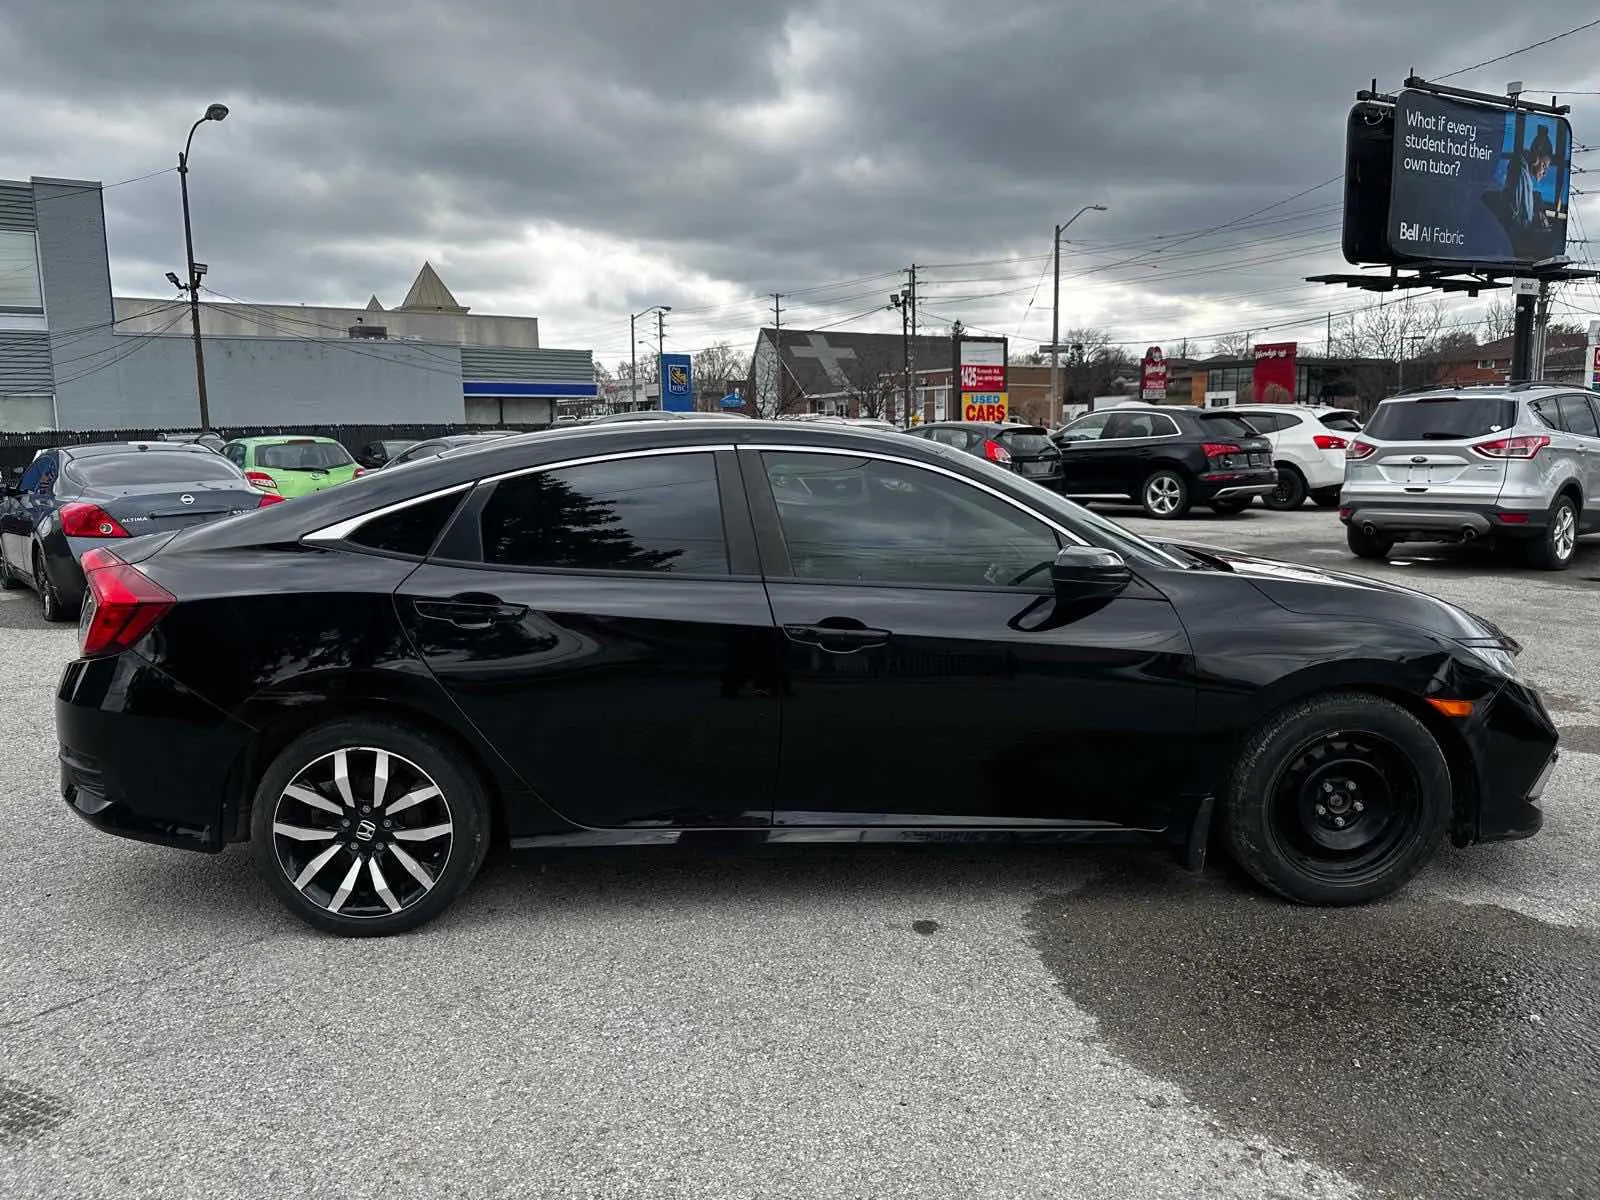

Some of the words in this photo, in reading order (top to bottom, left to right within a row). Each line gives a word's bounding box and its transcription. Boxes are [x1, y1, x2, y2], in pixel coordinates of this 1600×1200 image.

[1406, 109, 1436, 130] What
[1437, 116, 1446, 132] if
[1447, 121, 1477, 141] every
[1405, 134, 1446, 153] student
[1447, 137, 1467, 156] had
[1469, 142, 1492, 160] their
[1404, 157, 1428, 171] own
[1429, 160, 1461, 176] tutor?
[1400, 222, 1419, 241] Bell
[1421, 226, 1432, 241] AI
[1433, 227, 1464, 244] Fabric
[972, 395, 999, 404] USED
[966, 405, 1005, 421] CARS
